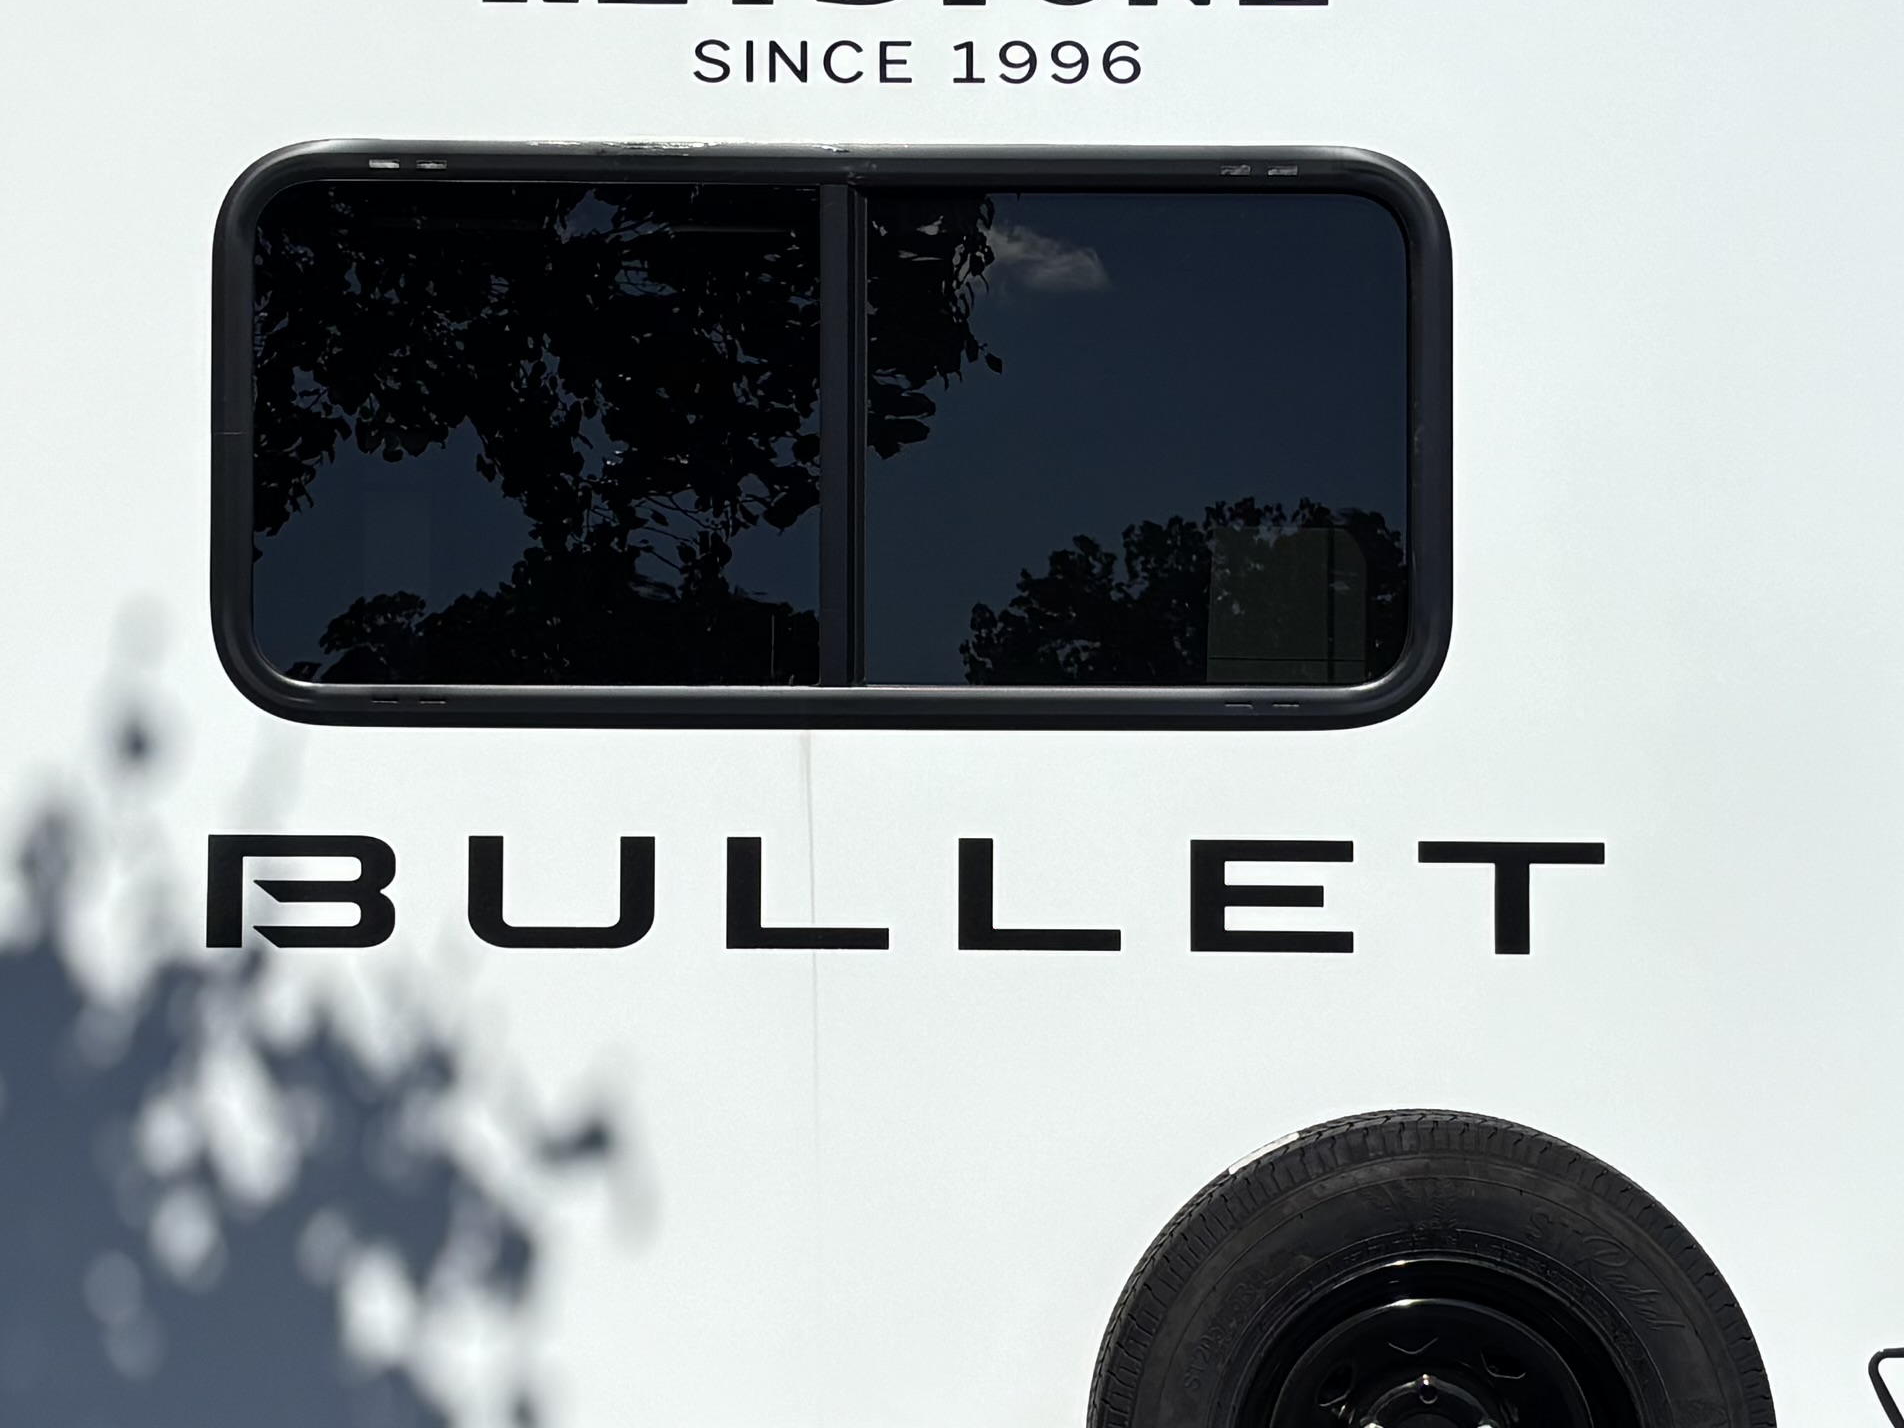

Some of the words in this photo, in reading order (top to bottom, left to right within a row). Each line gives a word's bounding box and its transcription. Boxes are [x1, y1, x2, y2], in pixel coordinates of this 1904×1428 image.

[693, 38, 913, 84] SINCE
[952, 40, 1142, 85] 1996
[206, 834, 1605, 955] BULLET
